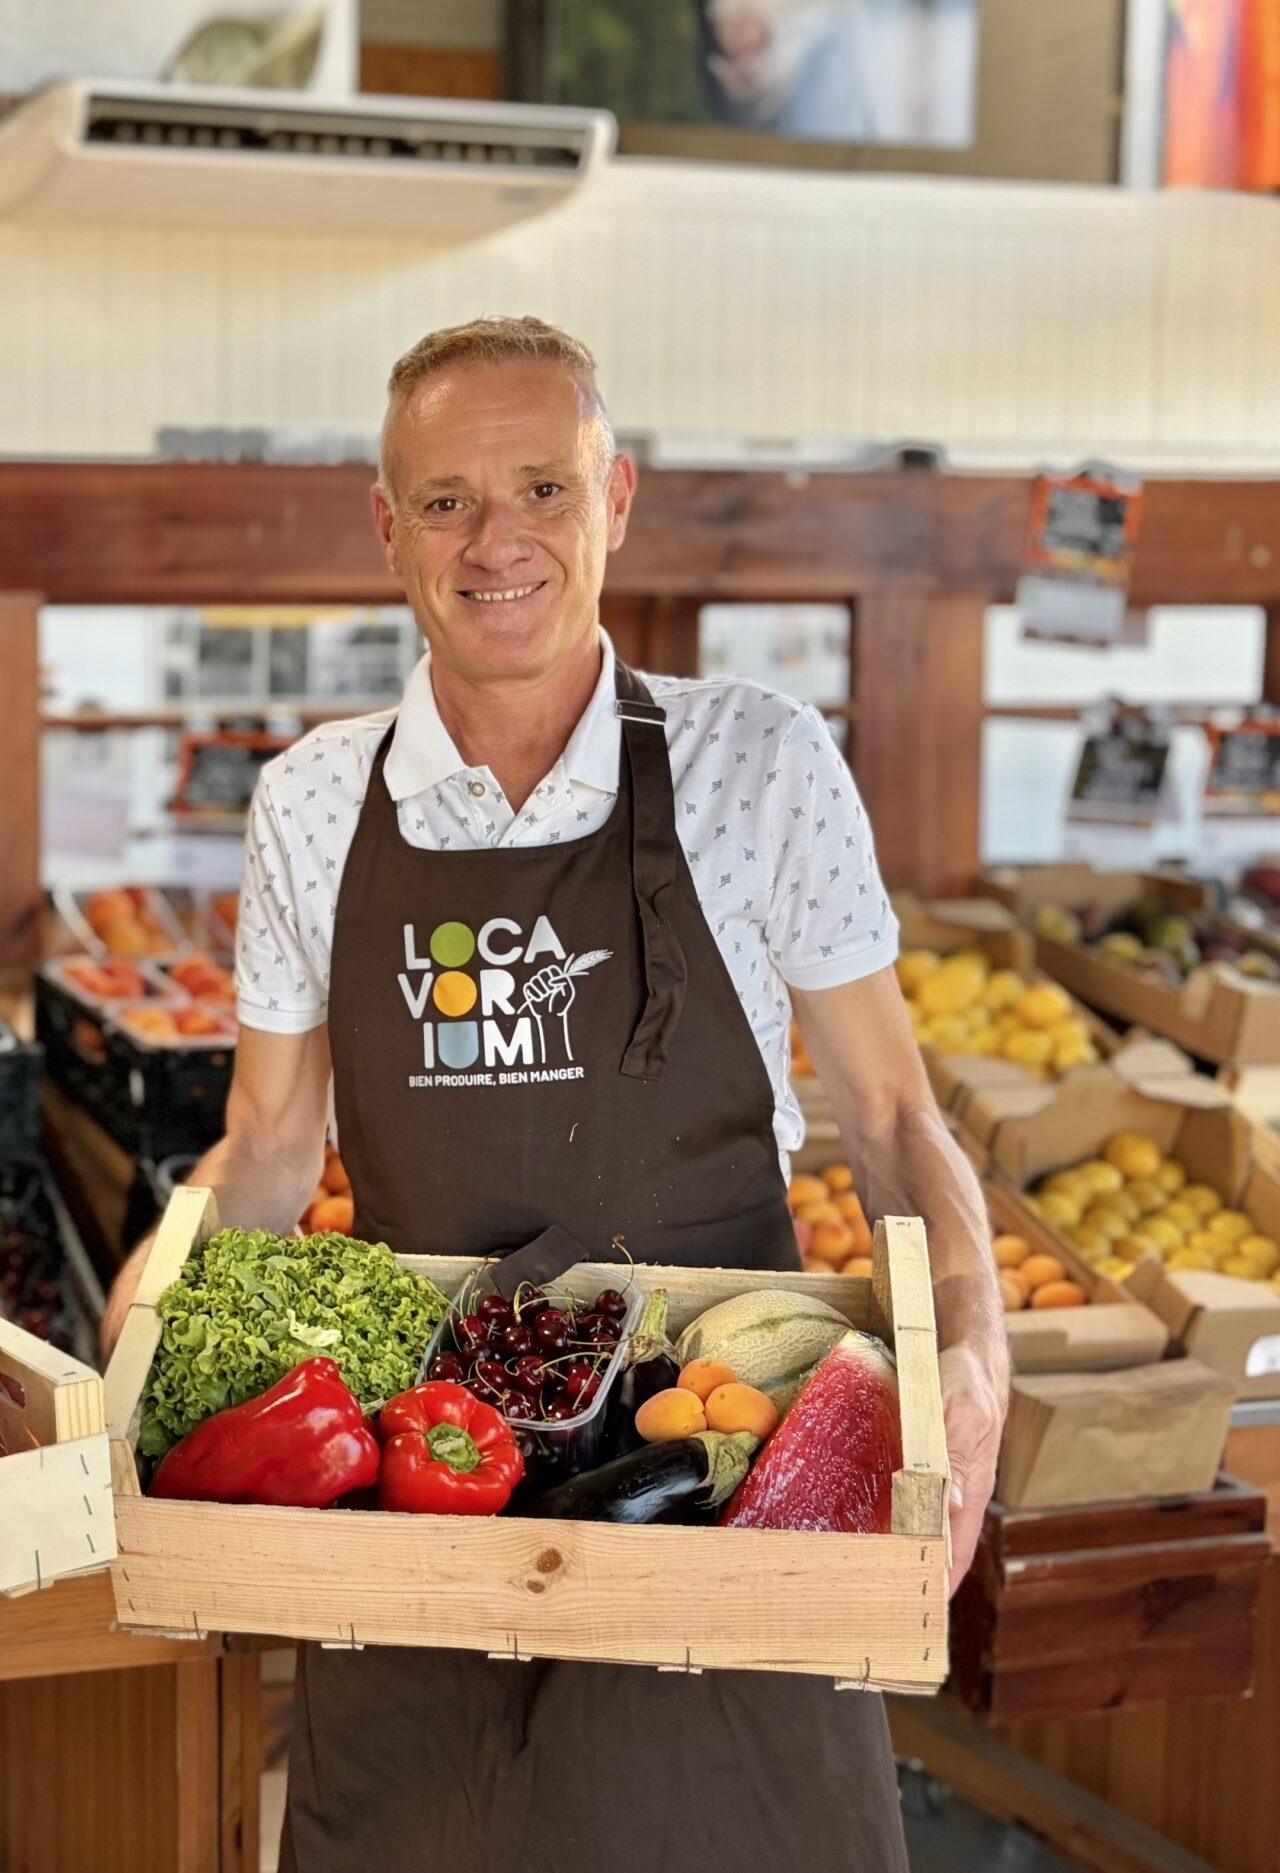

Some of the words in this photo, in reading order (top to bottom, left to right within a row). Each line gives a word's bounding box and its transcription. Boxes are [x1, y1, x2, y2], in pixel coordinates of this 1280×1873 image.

[403, 915, 566, 970] LOCA
[397, 968, 516, 1019] VOR
[423, 1017, 534, 1070] IUM
[409, 1075, 433, 1088] BIEN
[435, 1073, 496, 1087] PRODUIRE,
[499, 1071, 528, 1085] BIEN
[530, 1066, 585, 1083] MANGER
